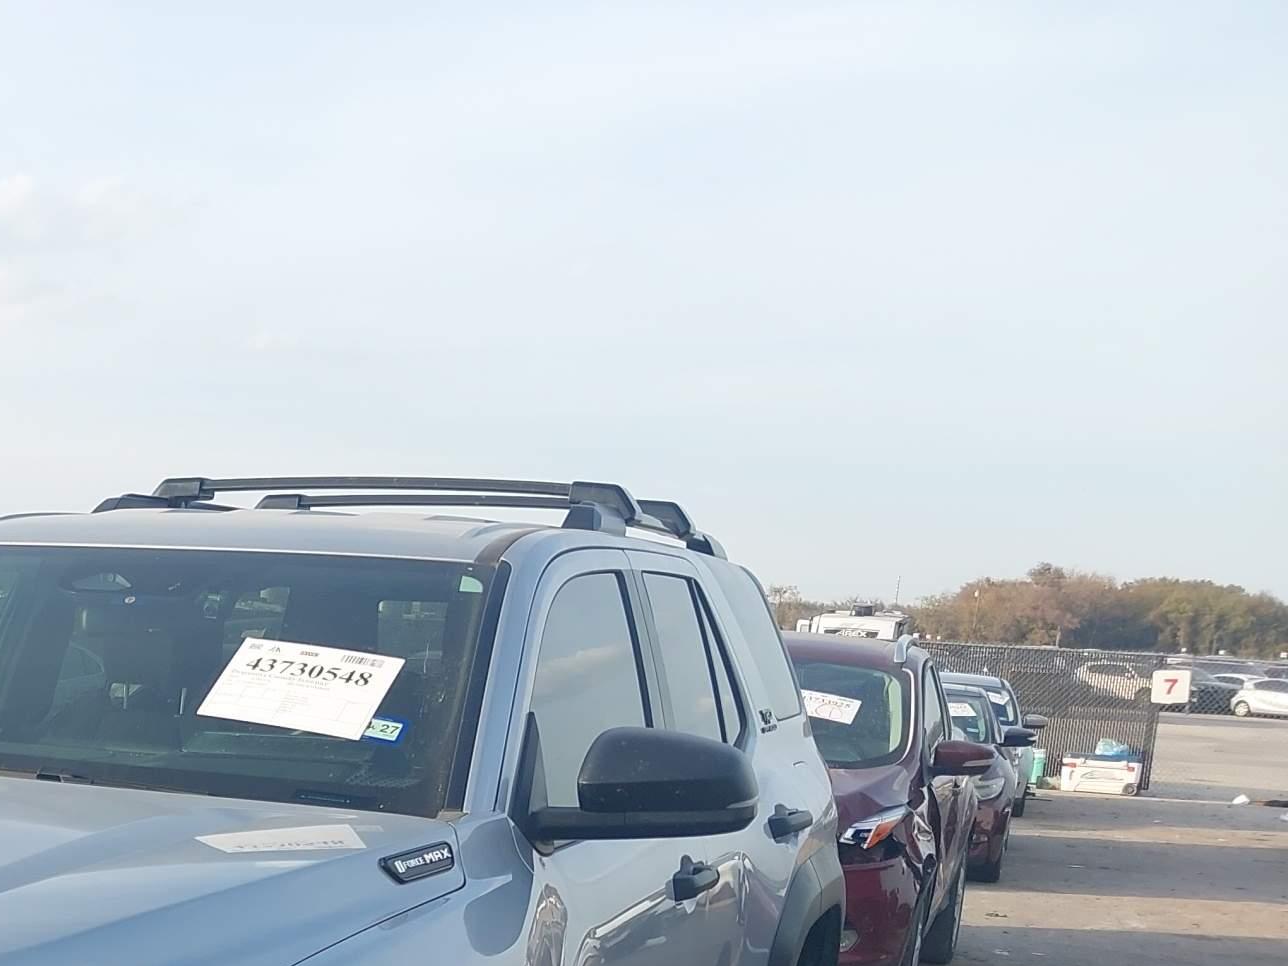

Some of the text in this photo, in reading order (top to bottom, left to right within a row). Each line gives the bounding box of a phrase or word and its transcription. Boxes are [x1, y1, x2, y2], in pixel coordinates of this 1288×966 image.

[245, 656, 373, 687] 43730548
[1164, 678, 1179, 695] 7
[379, 724, 401, 735] 27
[423, 847, 452, 864] MAX
